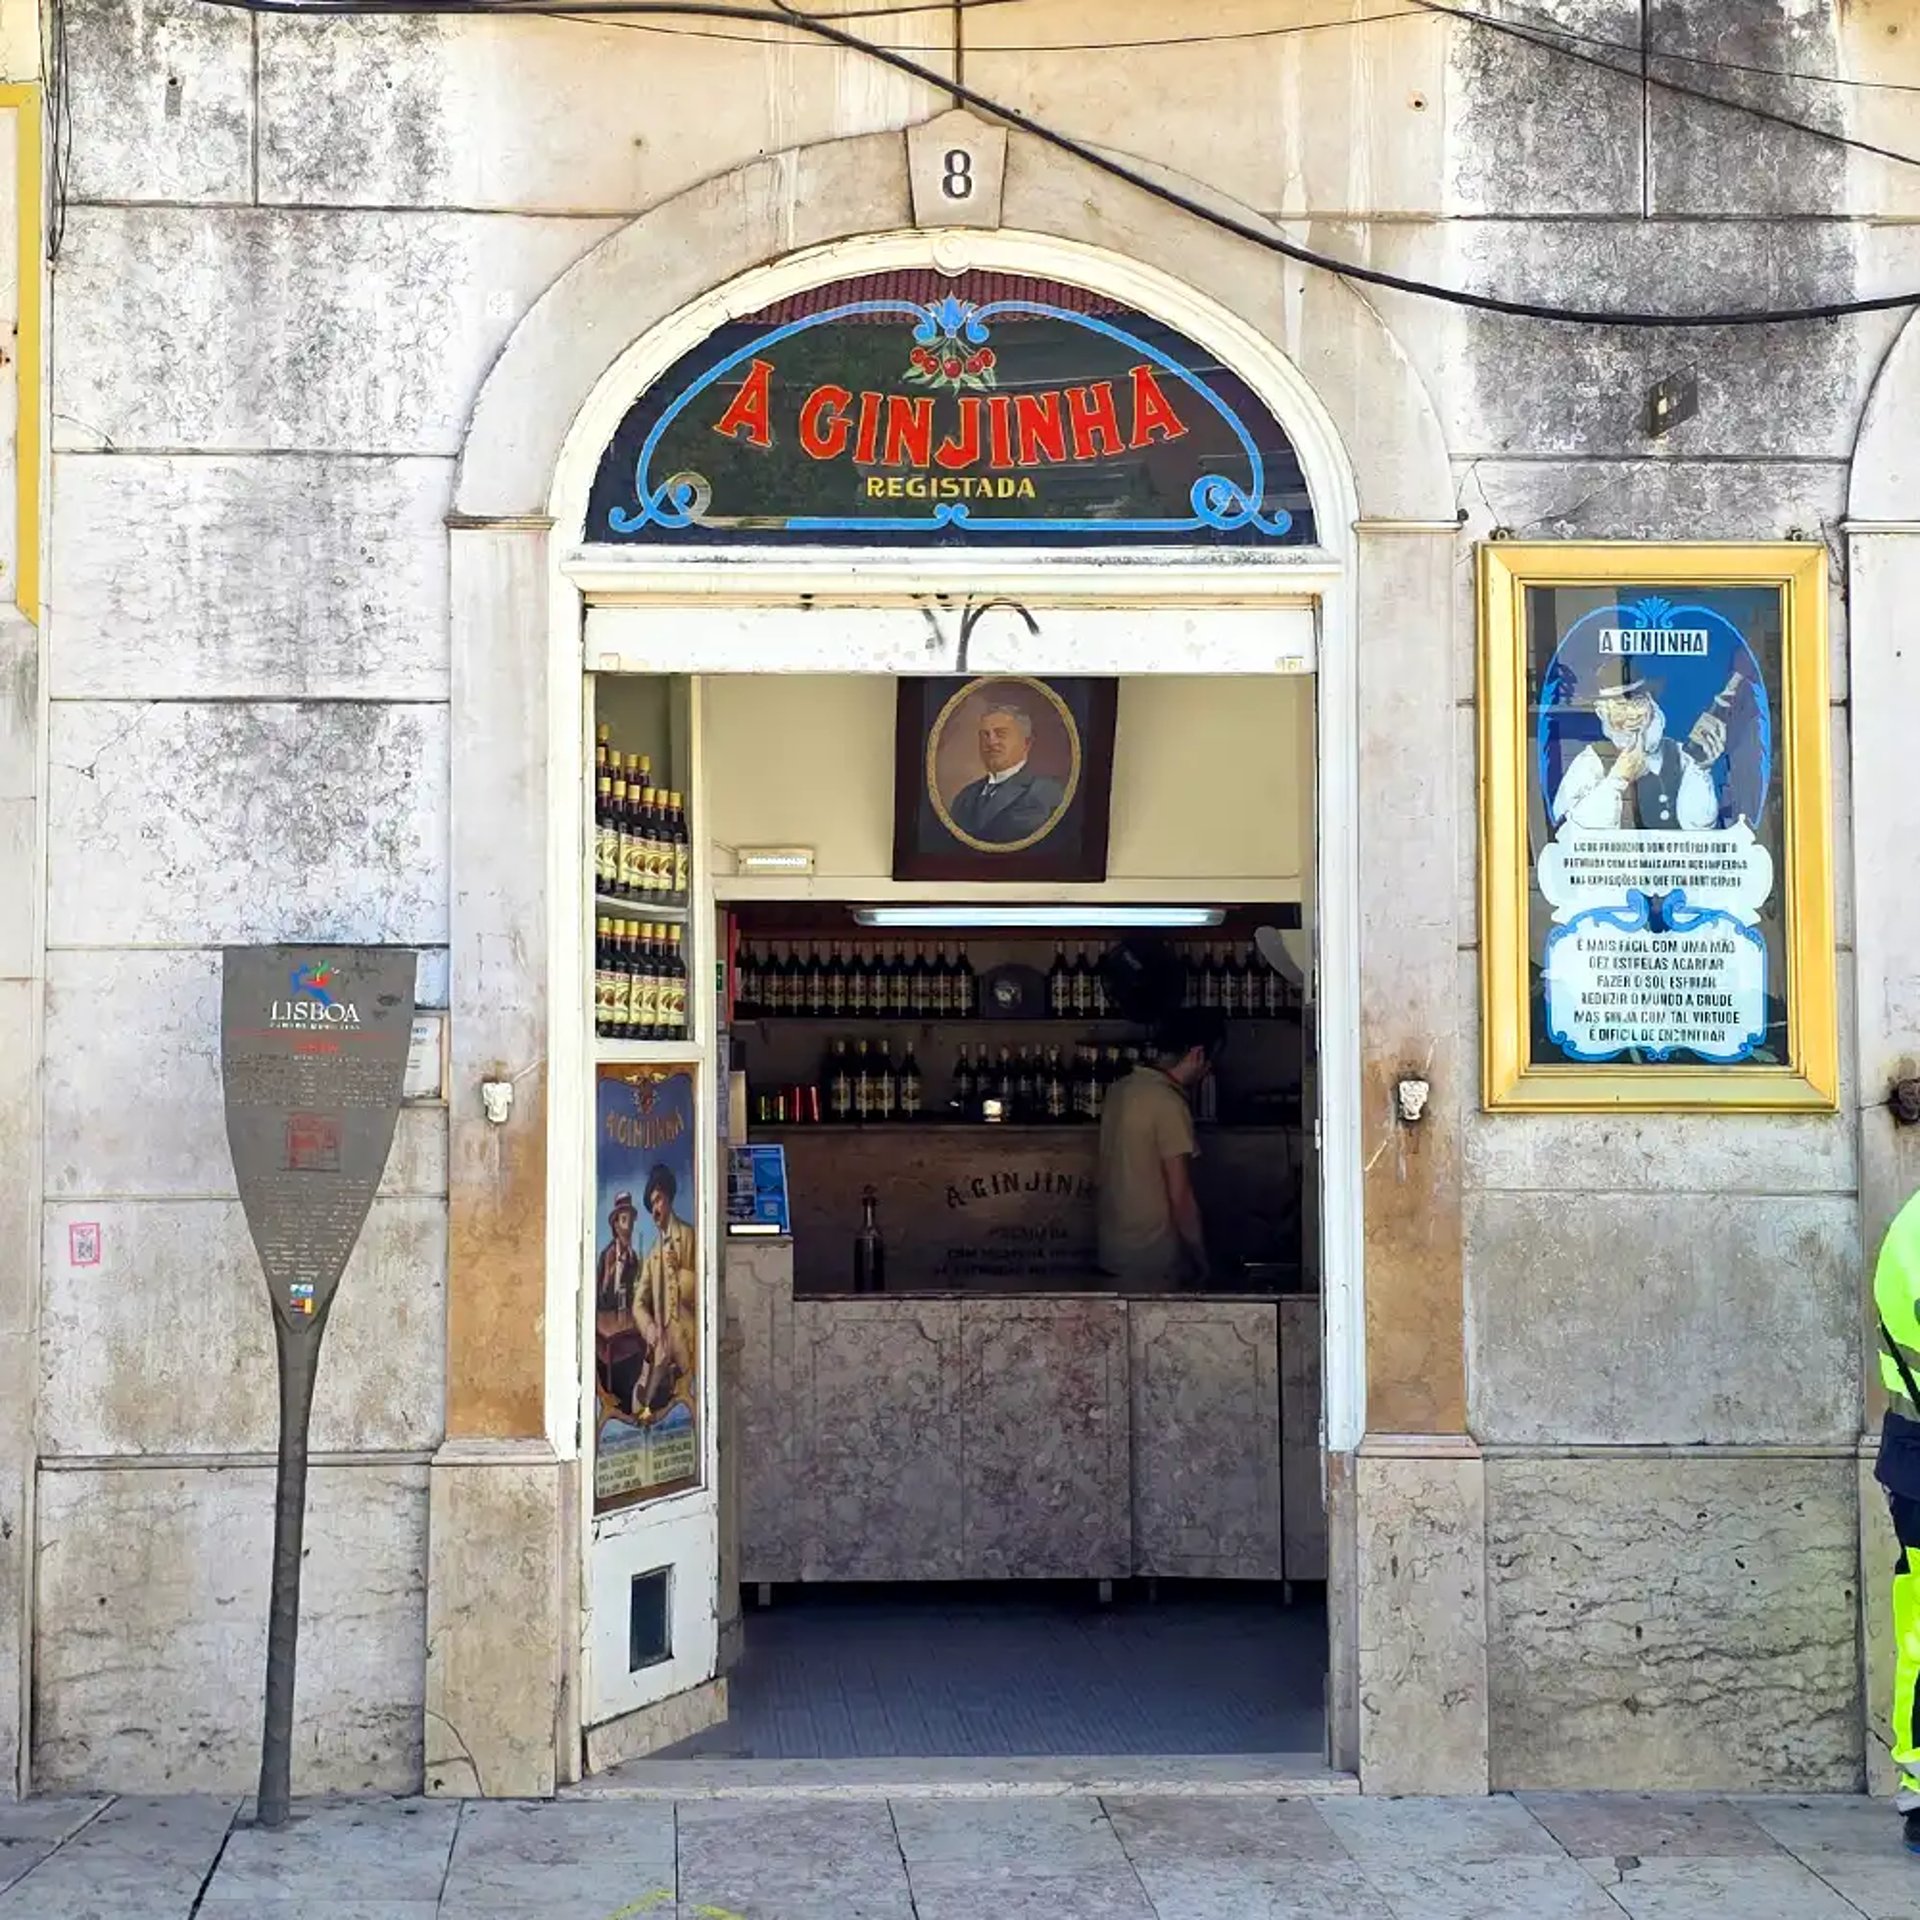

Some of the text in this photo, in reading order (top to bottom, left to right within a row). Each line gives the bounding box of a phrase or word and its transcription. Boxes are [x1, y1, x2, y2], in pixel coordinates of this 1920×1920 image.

[942, 149, 972, 199] 8
[713, 359, 1189, 470] A GINJINHA
[866, 477, 1036, 499] REGISTADA
[1602, 631, 1612, 652] A
[1652, 940, 1677, 953] COM
[1645, 975, 1665, 989] SOL
[270, 1001, 361, 1022] LISBOA
[1574, 1011, 1600, 1024] MAS
[1671, 1012, 1689, 1023] TAL
[1693, 1011, 1740, 1024] VIRTUDE
[971, 1171, 1098, 1199] GINJINH
